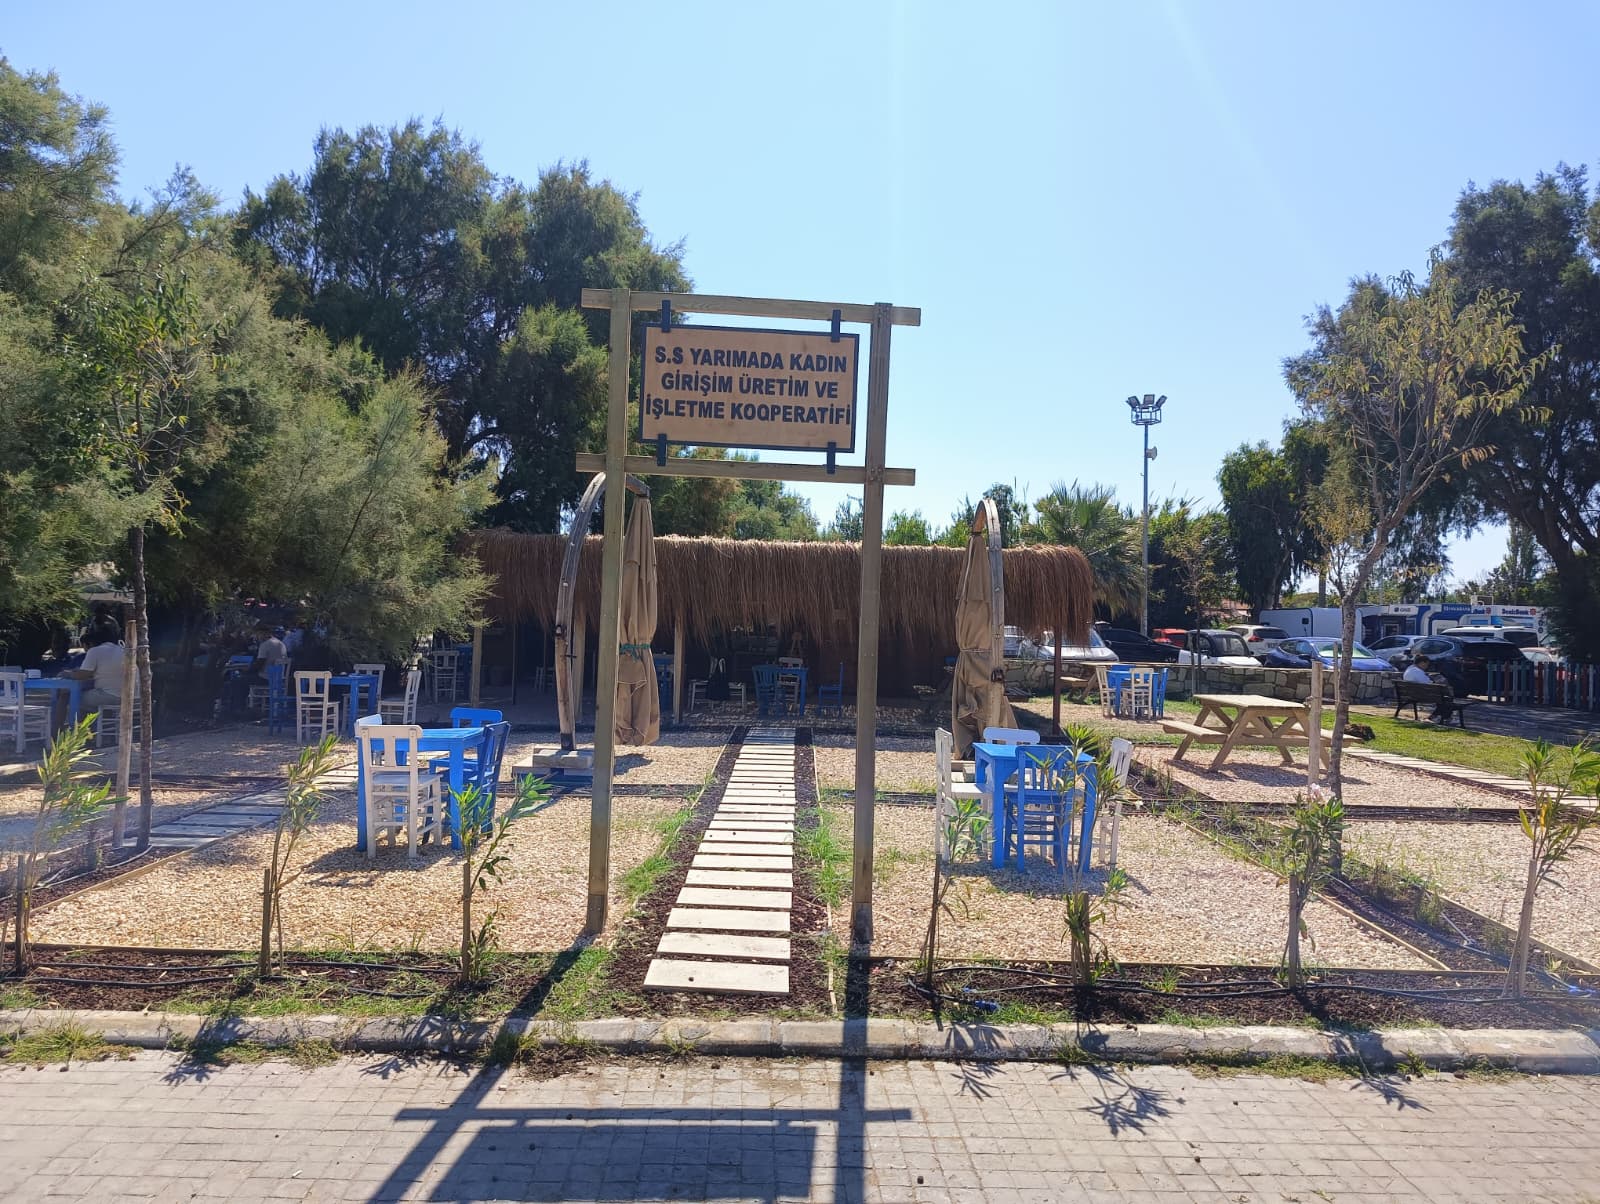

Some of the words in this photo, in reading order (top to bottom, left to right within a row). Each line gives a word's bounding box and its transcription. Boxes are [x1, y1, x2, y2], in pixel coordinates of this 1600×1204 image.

[655, 346, 684, 364] S.S
[690, 348, 784, 370] YARIMADA
[789, 353, 847, 373] KADIN
[661, 369, 733, 397] GİRİŞİM
[739, 373, 809, 397] ÜRETİM
[815, 381, 838, 398] VE
[645, 393, 725, 420] İŞLETME
